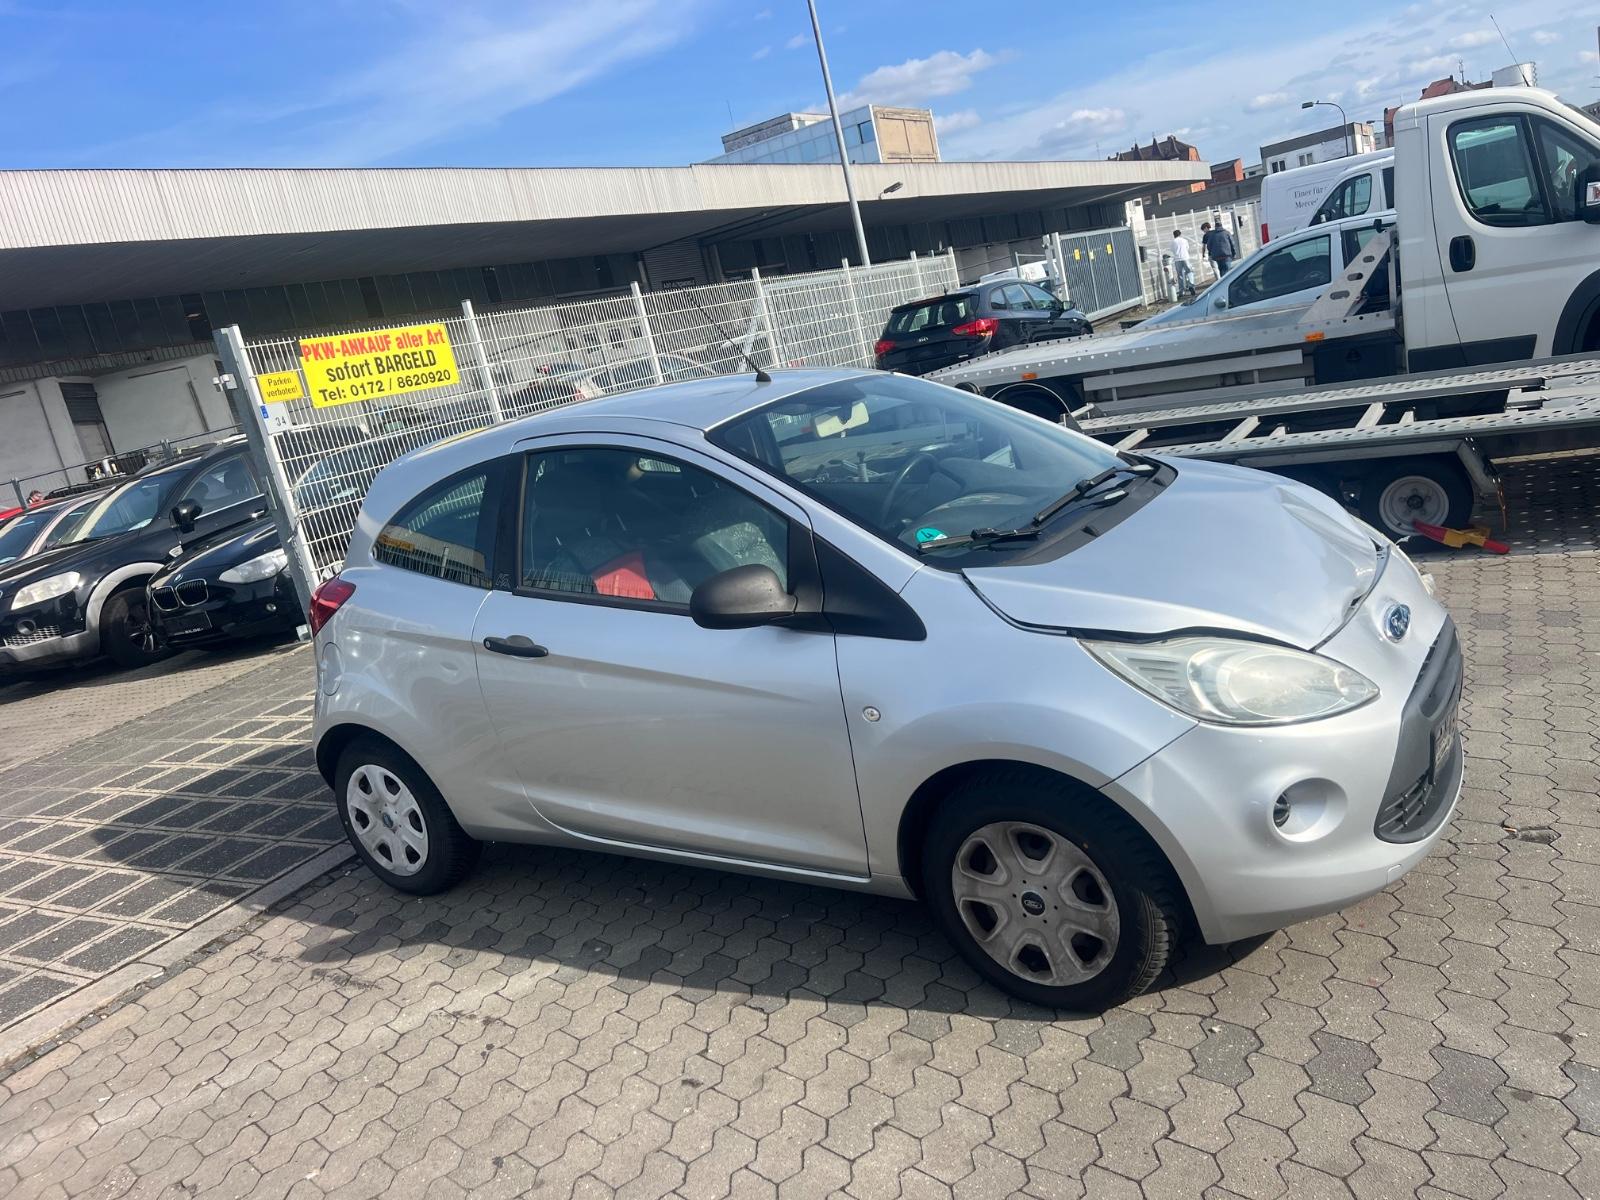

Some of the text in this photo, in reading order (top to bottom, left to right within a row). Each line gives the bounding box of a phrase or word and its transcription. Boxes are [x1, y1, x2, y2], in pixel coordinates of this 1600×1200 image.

[301, 329, 445, 362] PKW-ANKAUF aller Art
[267, 377, 292, 386] Parken
[326, 349, 436, 382] sofort BARGELD
[267, 385, 298, 397] verboten!
[319, 387, 346, 401] Tel:
[350, 380, 385, 396] 0172
[397, 369, 451, 388] 8620920
